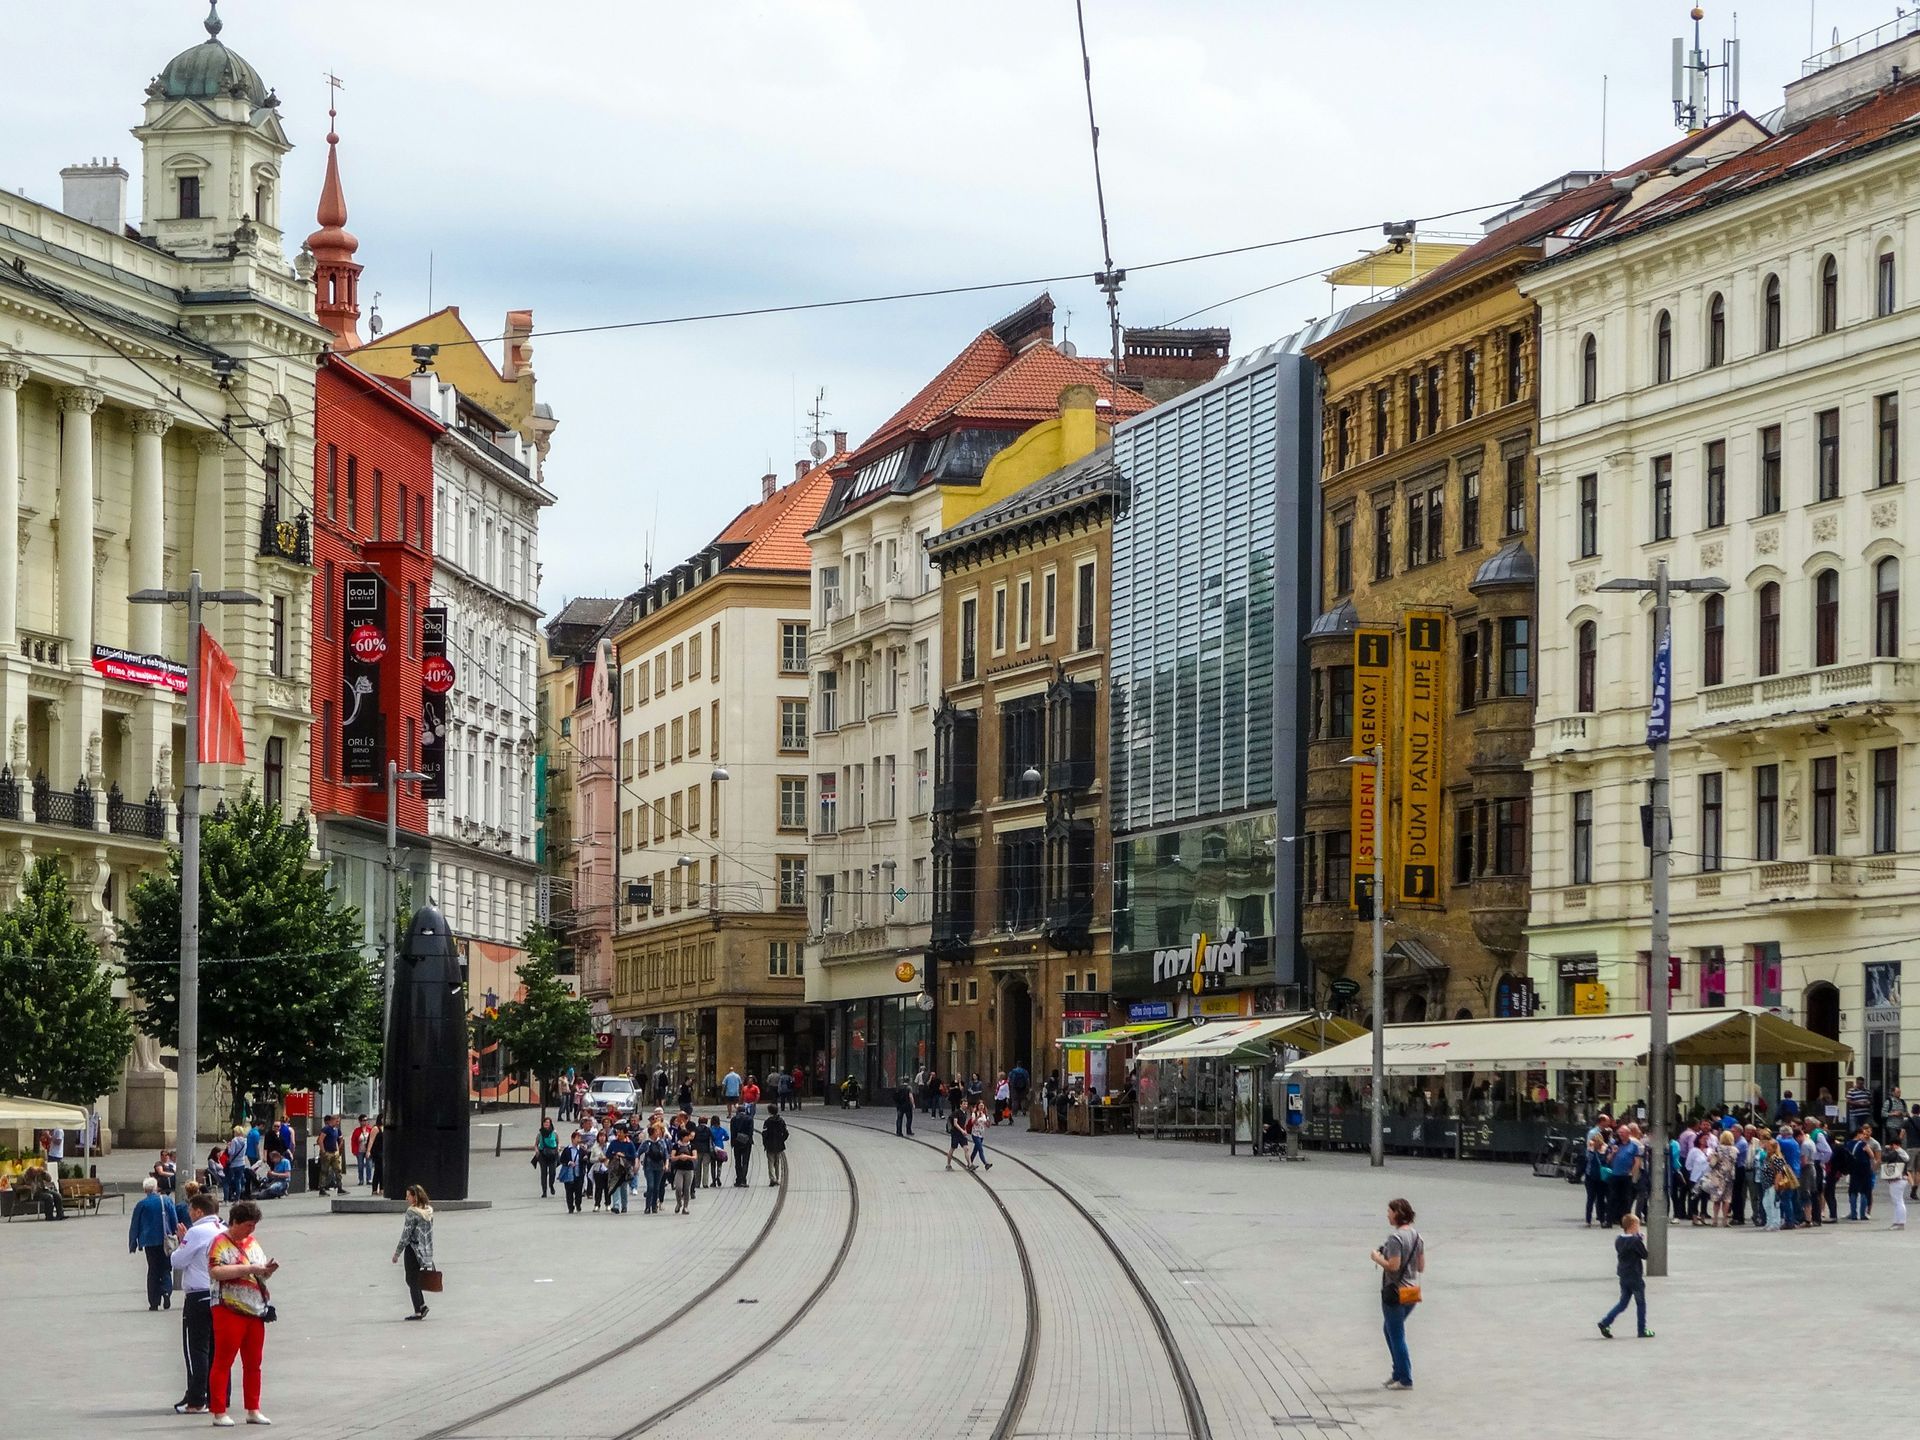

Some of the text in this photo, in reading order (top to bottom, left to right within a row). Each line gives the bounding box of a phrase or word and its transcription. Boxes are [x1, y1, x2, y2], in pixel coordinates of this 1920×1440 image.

[360, 629, 377, 637] sleva
[351, 638, 386, 652] -60%
[348, 737, 375, 746] ORLÍ 3
[1408, 659, 1431, 856] DŮM PÁNŮ Z LIPÉ
[421, 762, 441, 771] RLÍ 3
[1360, 683, 1377, 857] STUDENT AGENCY
[1520, 984, 1528, 1017] estaurant
[1866, 1011, 1900, 1022] KLENOTY
